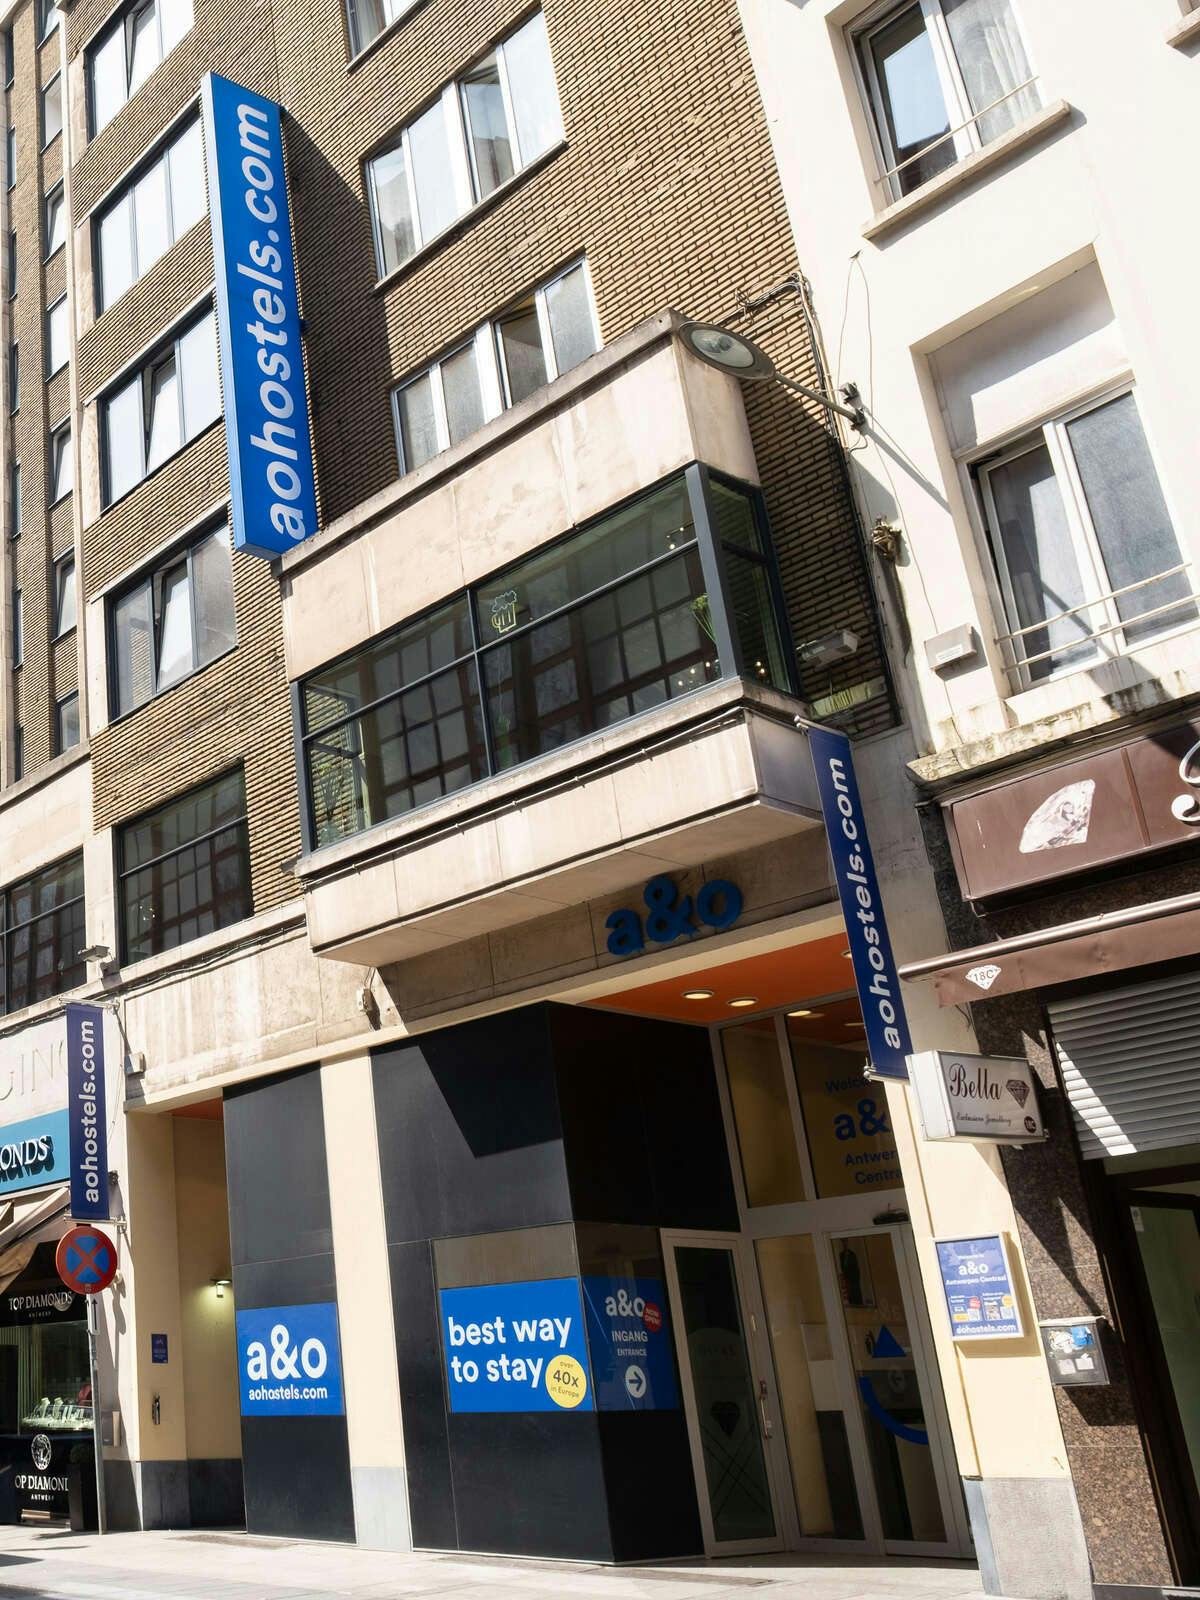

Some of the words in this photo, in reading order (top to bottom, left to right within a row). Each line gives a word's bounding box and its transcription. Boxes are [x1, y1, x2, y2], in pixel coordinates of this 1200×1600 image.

[236, 103, 305, 541] aohostels.com
[605, 875, 743, 956] a&o
[829, 757, 900, 1049] aohostels.com
[949, 1063, 1002, 1100] Bella
[78, 1020, 99, 1203] aohostels.com
[958, 1261, 989, 1276] a&o
[8, 1297, 24, 1311] TOP
[26, 1291, 73, 1309] DIAMONDS
[605, 1289, 644, 1317] a&o
[448, 1316, 506, 1346] best
[512, 1317, 572, 1348] way
[611, 1330, 648, 1342] INGANG
[247, 1324, 327, 1380] a&o
[617, 1348, 647, 1356] ENTRANCE
[451, 1356, 479, 1382] to
[486, 1354, 543, 1388] stay
[553, 1369, 579, 1387] 40x
[249, 1384, 327, 1400] aohostels.com
